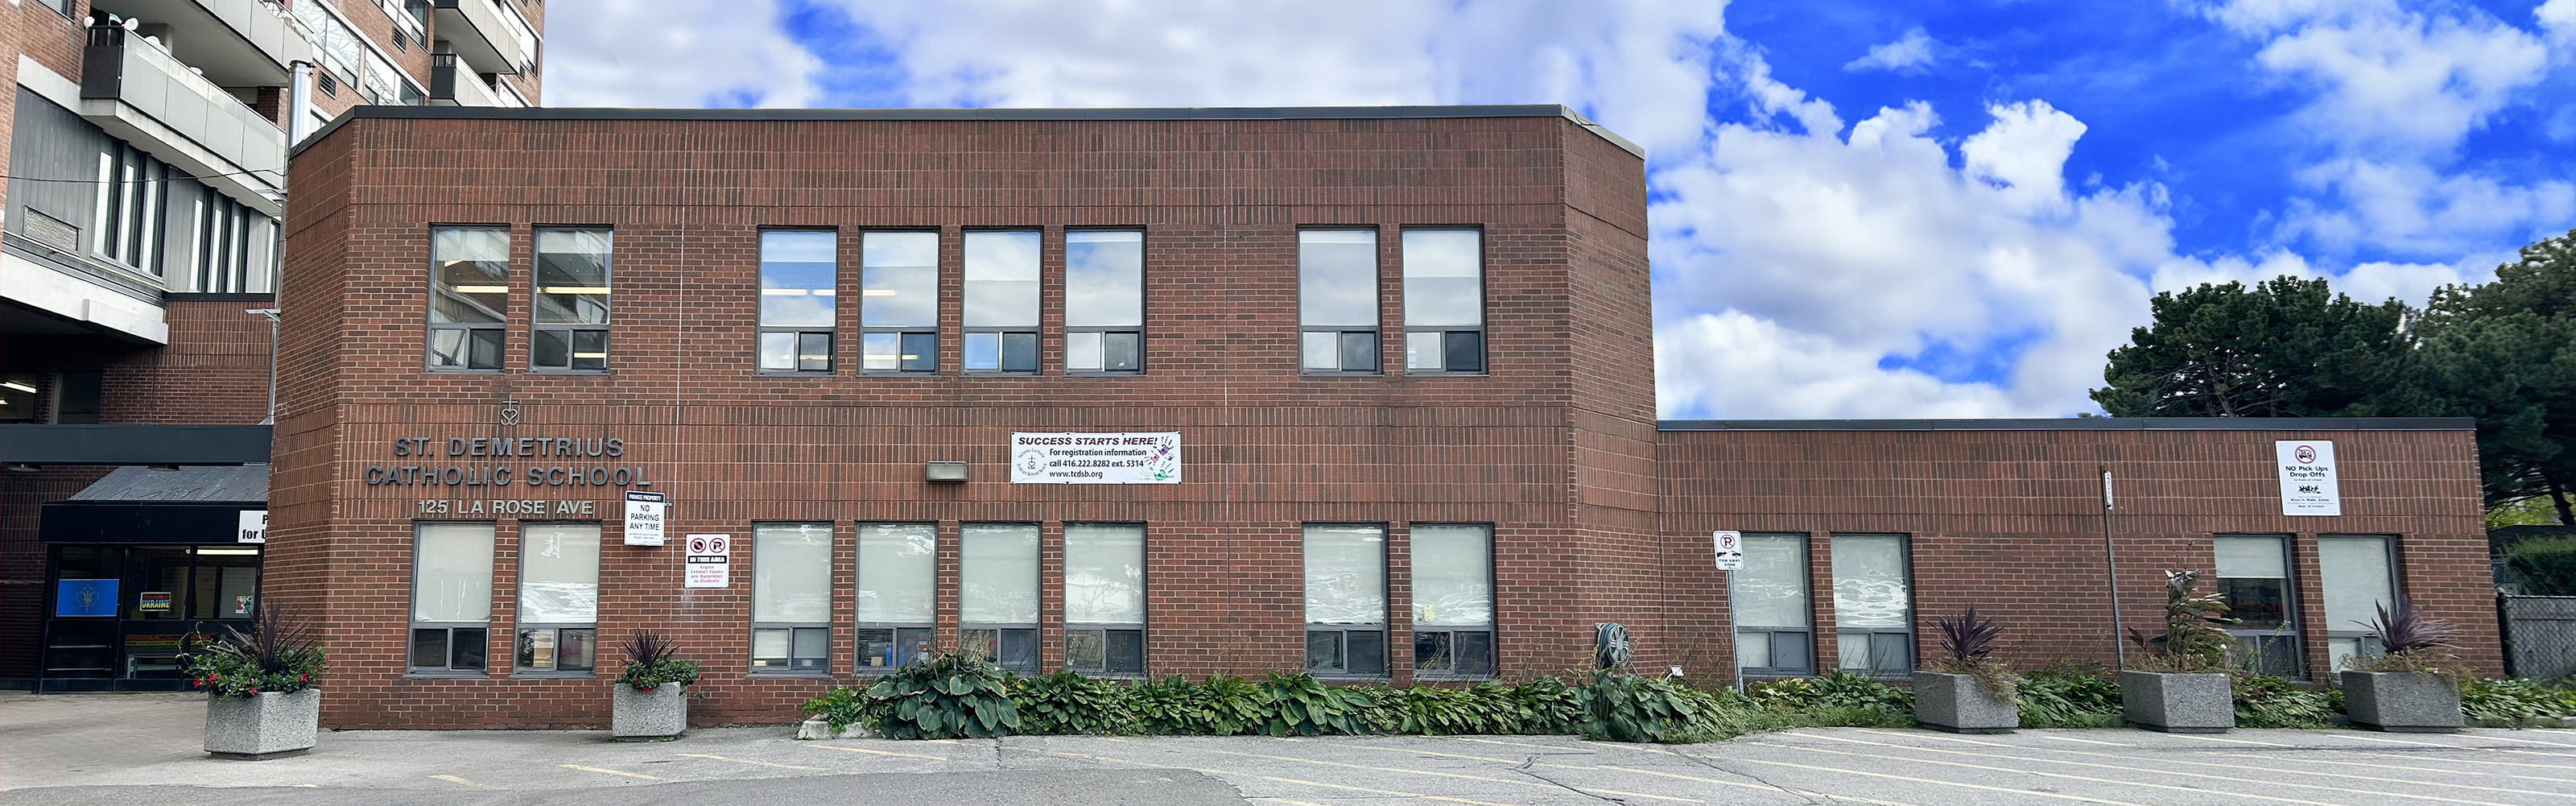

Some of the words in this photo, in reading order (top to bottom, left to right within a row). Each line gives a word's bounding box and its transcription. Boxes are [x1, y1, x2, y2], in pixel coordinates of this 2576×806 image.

[1018, 437, 1072, 445] SUCCESS
[1075, 437, 1120, 445] STARTS
[1122, 437, 1158, 445] HERE!
[394, 437, 434, 456] ST.
[448, 437, 624, 457] DEMETRIUS
[1062, 448, 1103, 458] registration
[365, 465, 511, 486] CATHOLIC
[527, 466, 651, 486] SCHOOL
[1049, 470, 1103, 479] www.tcdsb.org
[419, 500, 448, 514] 125
[458, 500, 484, 514] LA
[492, 500, 545, 514] ROSE
[556, 500, 593, 515] AVE
[242, 529, 258, 539] for
[142, 599, 170, 608] UKRAINE
